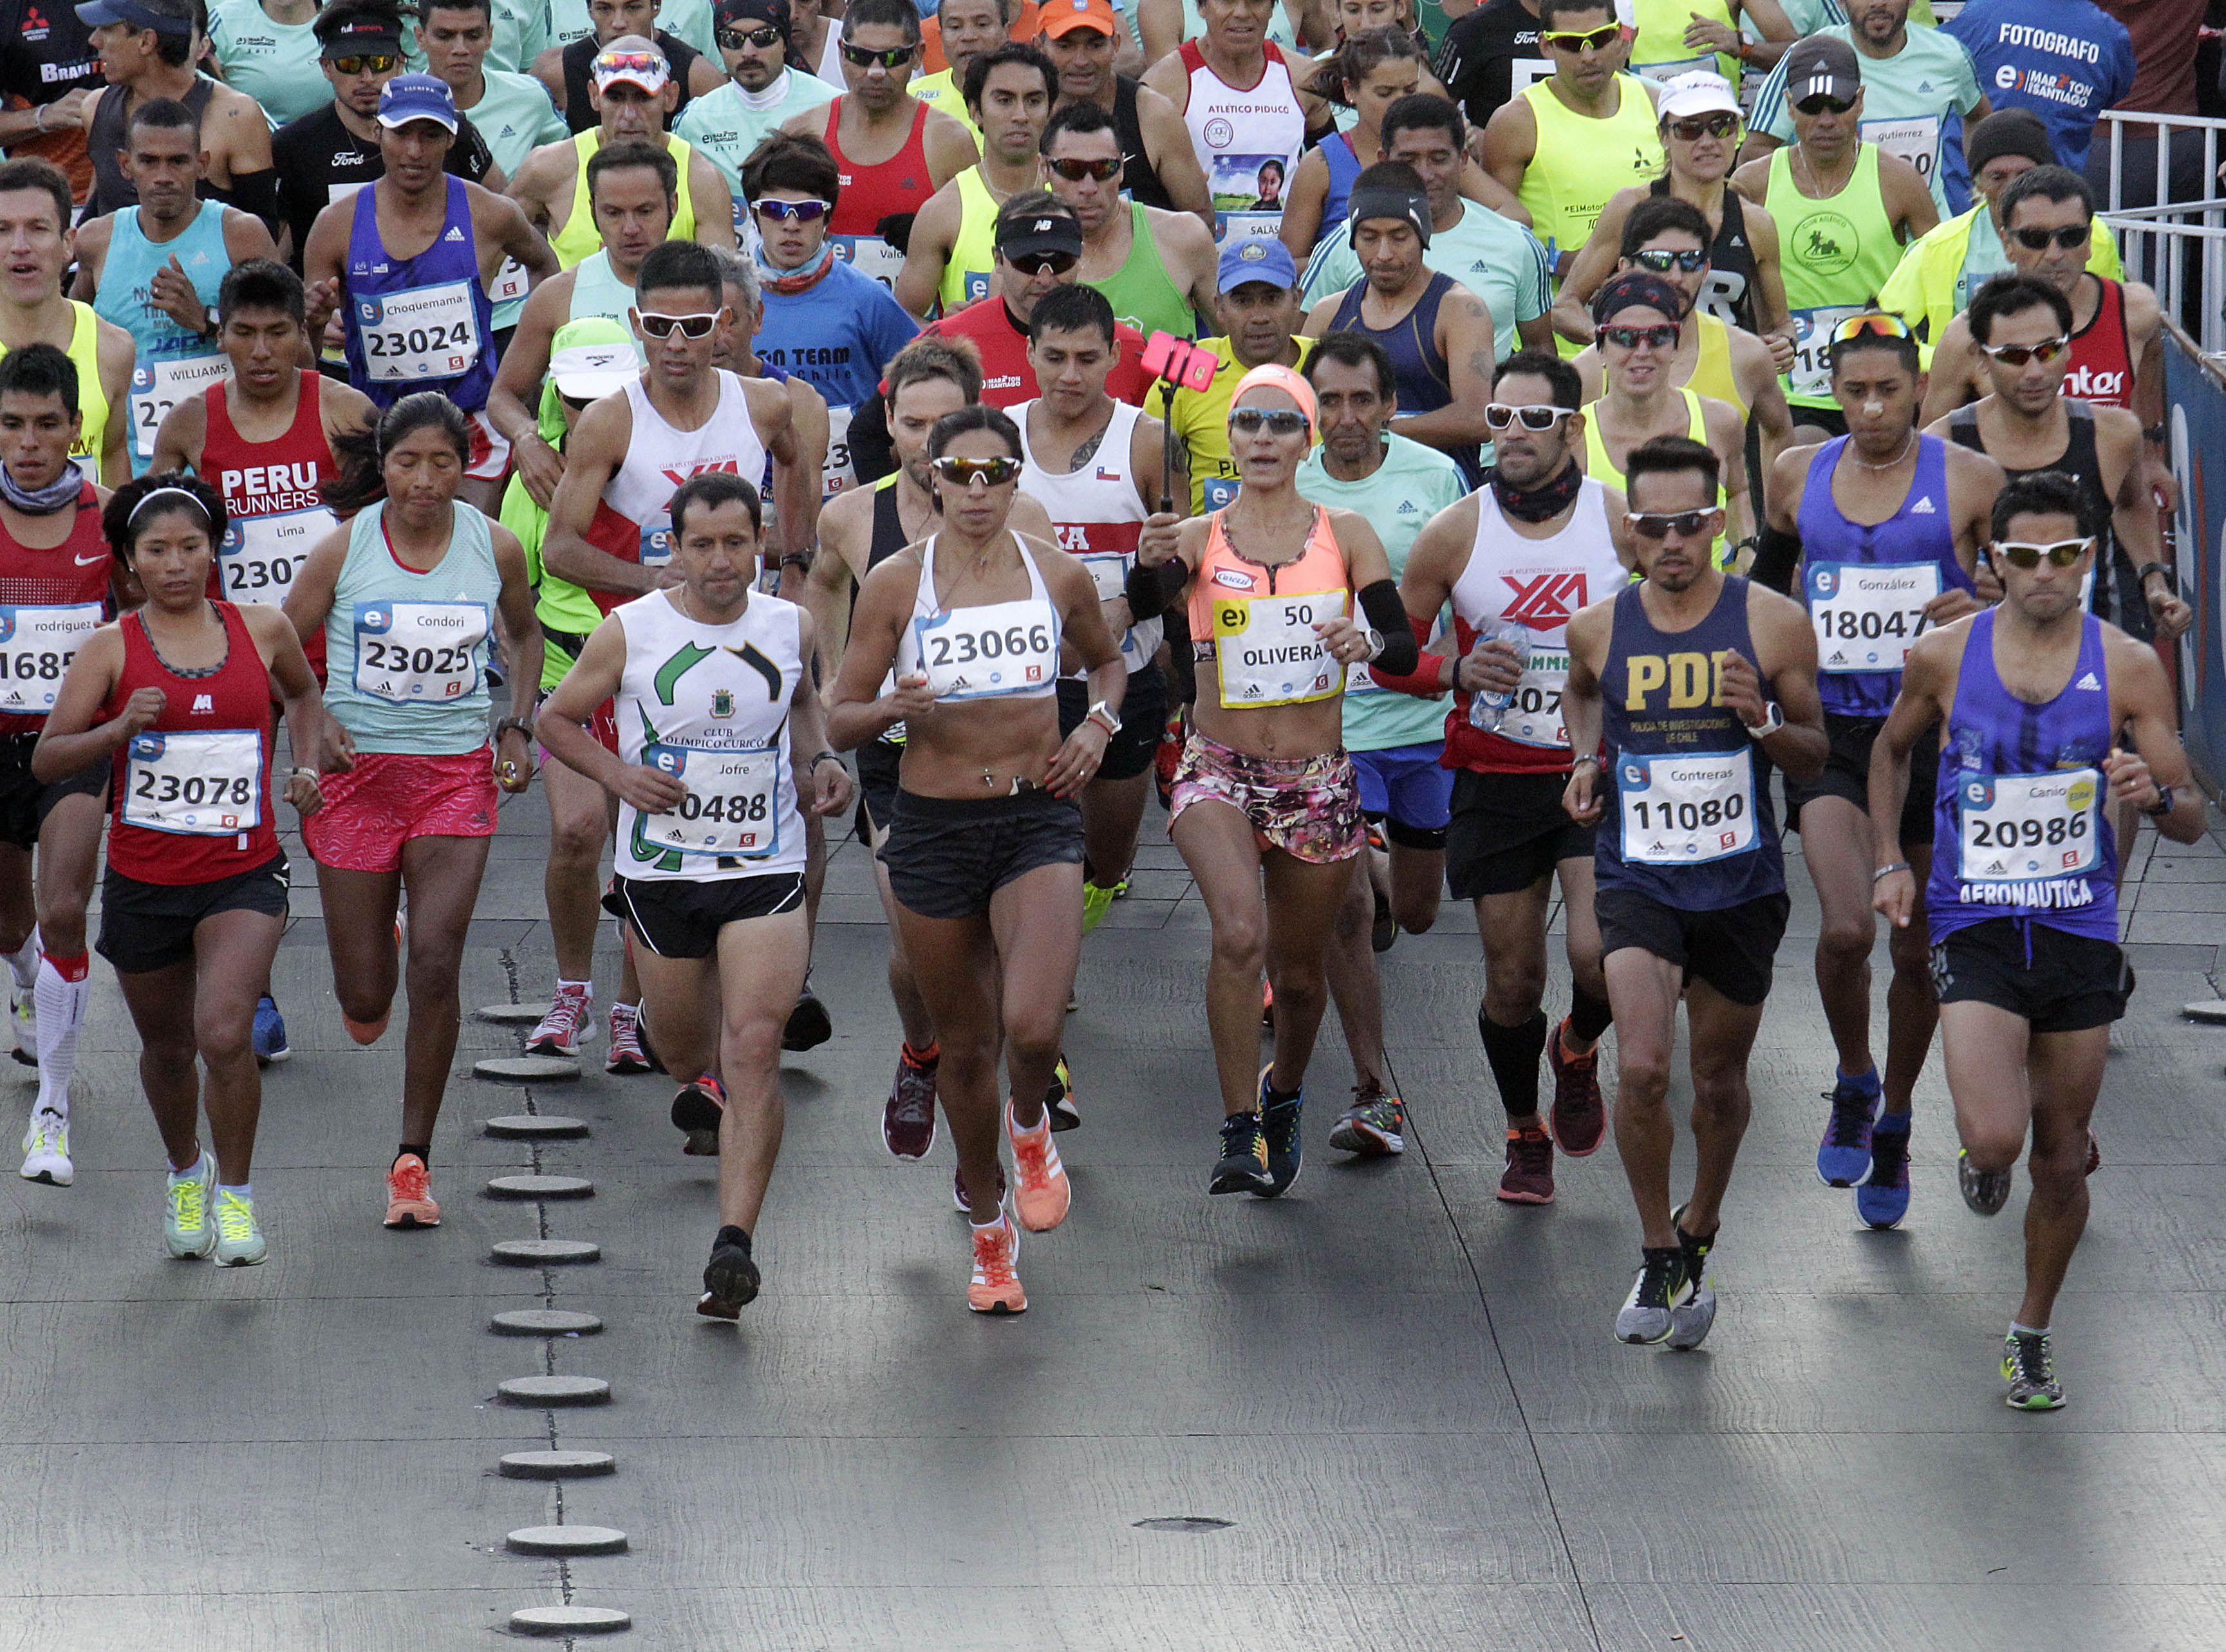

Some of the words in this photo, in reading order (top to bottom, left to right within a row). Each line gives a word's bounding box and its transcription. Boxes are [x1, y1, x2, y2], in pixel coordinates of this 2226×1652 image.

[1999, 23, 2100, 64] FOTOGRAFO
[1878, 130, 1923, 142] gutierrez
[332, 152, 364, 167] Ford
[387, 295, 467, 316] Choquemama-
[368, 321, 471, 357] 23024
[792, 346, 850, 366] TEAM
[170, 364, 227, 380] WILLIAMS
[221, 461, 318, 498] PERU
[225, 489, 319, 515] RUNNERS
[277, 526, 304, 538] Lima
[416, 616, 464, 627] Condori
[1284, 605, 1313, 626] 50
[1820, 609, 1930, 640] 18047
[35, 620, 91, 633] rodriguez
[930, 624, 1050, 667] 23066
[1243, 644, 1323, 666] OLIVERA
[366, 642, 469, 673] 23025
[666, 736, 722, 748] OLÍMPICO
[724, 737, 764, 748] CURICÓ
[704, 728, 733, 738] CLUB
[719, 763, 750, 775] Jofre
[1670, 768, 1734, 782] Contreras
[136, 769, 250, 805] 23078
[664, 792, 767, 824] 0488
[1632, 793, 1744, 831] 11080
[1972, 810, 2087, 848] 20986
[1959, 877, 2093, 909] AERONAUTICA
